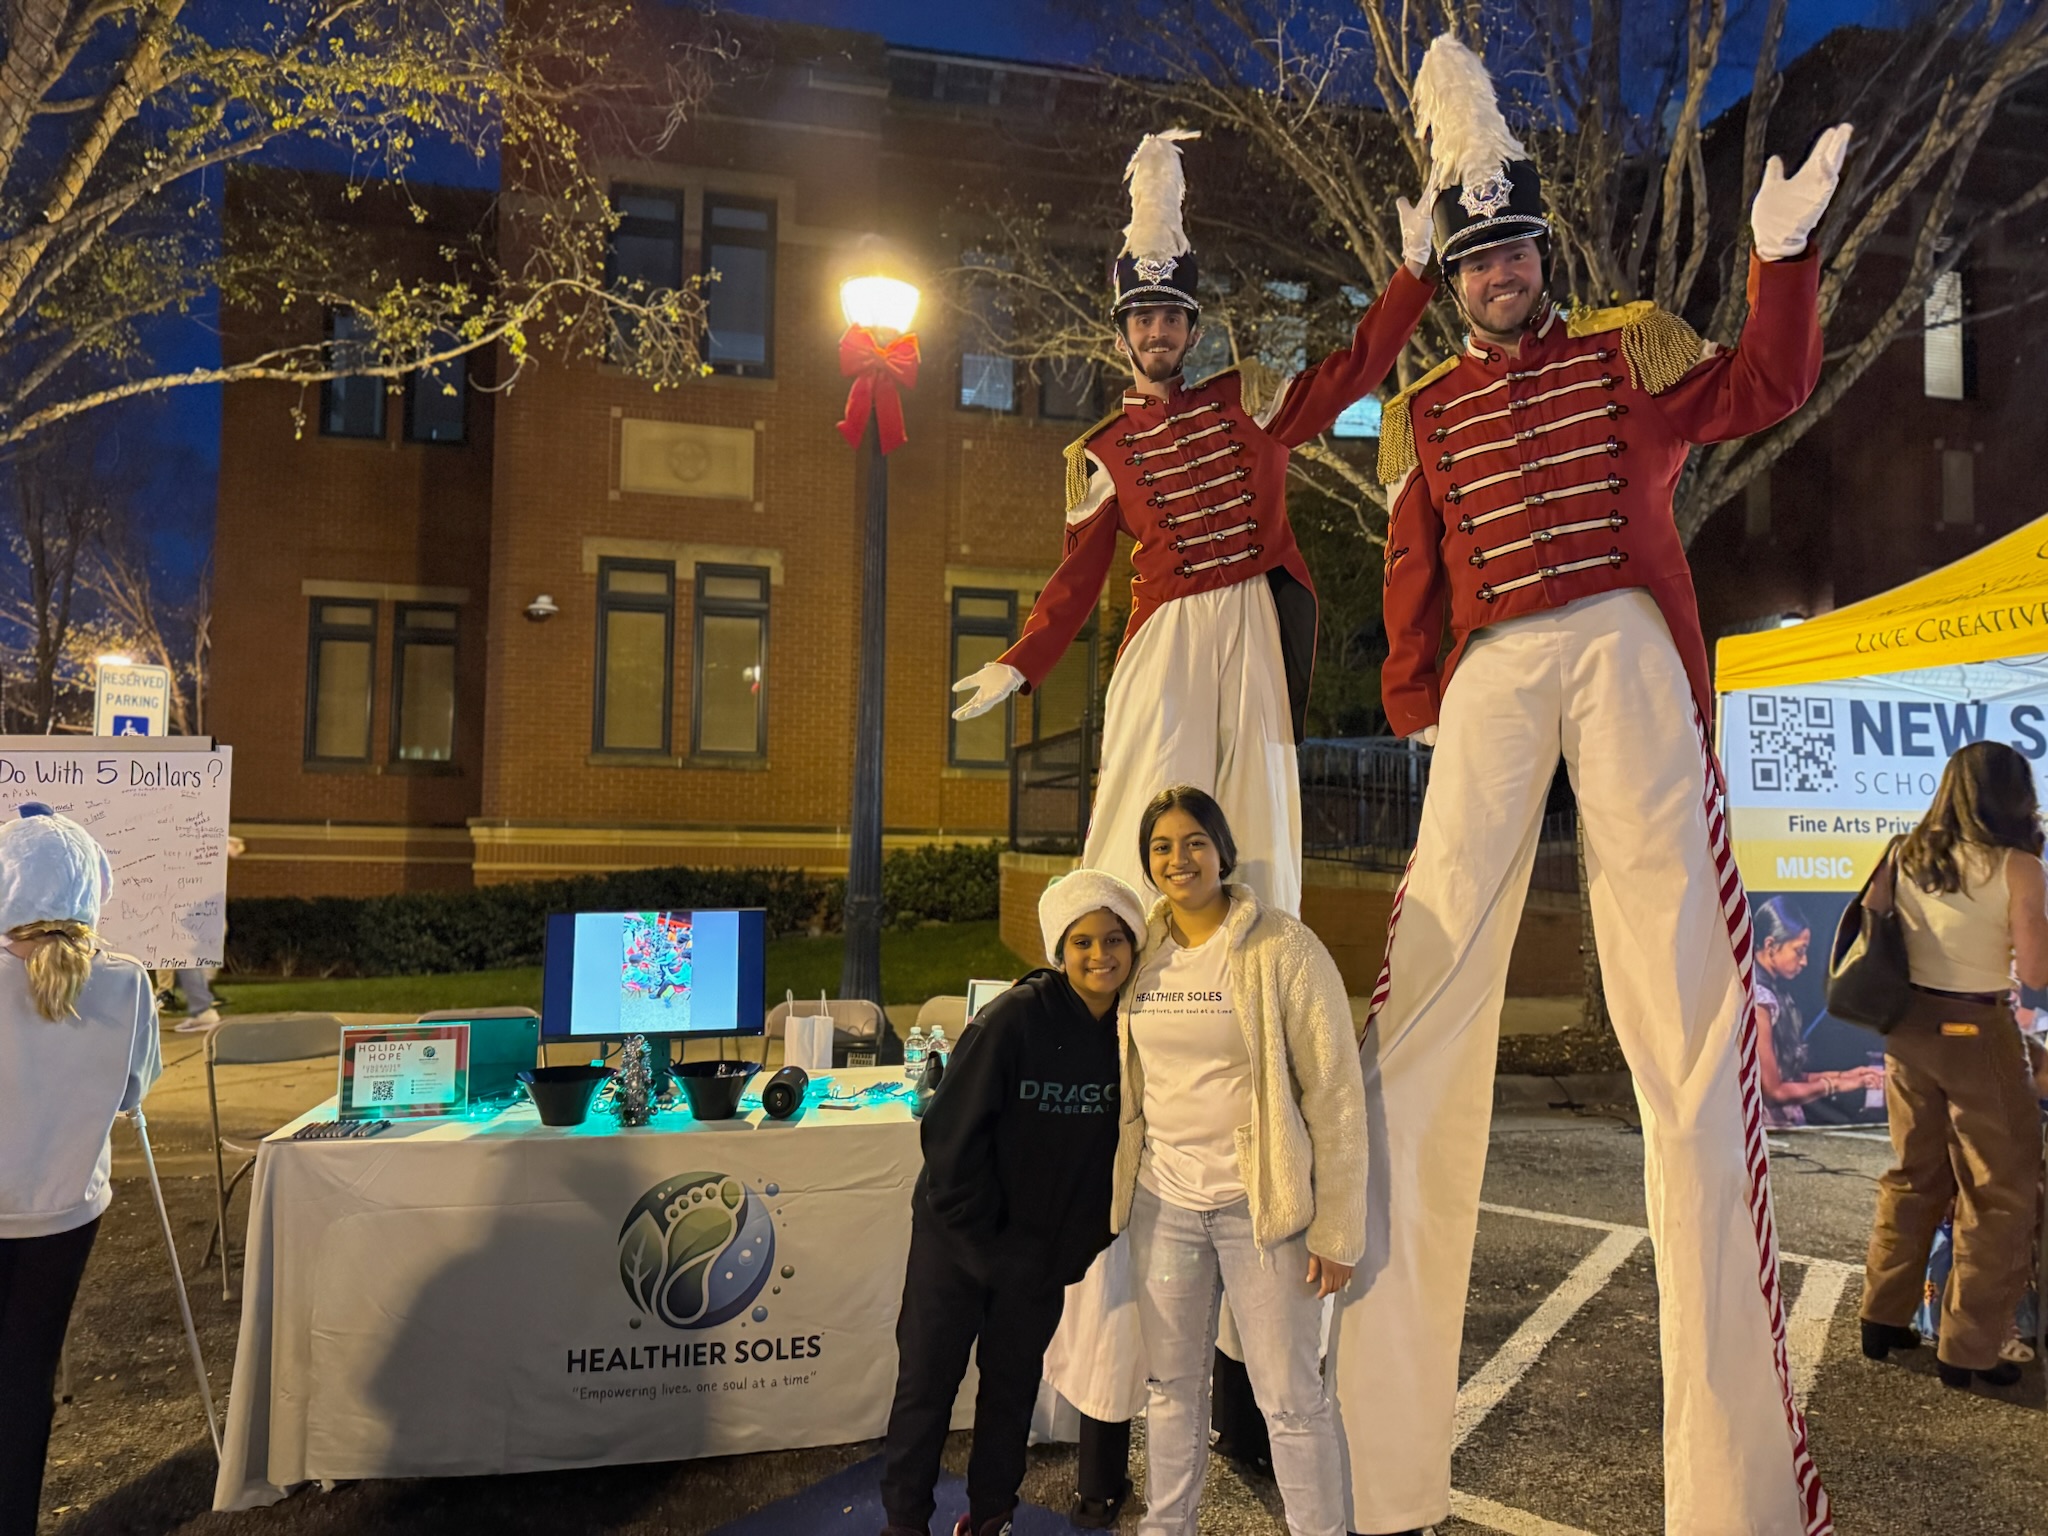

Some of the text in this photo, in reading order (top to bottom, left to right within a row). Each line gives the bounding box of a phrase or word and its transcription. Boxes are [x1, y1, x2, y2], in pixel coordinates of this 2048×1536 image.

[1855, 627, 1909, 654] LIVE
[103, 672, 164, 689] RESERVED
[106, 692, 159, 709] PARKING
[1850, 699, 1988, 757] NEW
[0, 759, 26, 784] Do
[36, 760, 83, 785] With
[96, 760, 118, 785] 5
[130, 760, 201, 788] Dollars
[1854, 771, 1936, 796] SCHO
[1788, 815, 1920, 834] Fine Arts Priva
[1776, 856, 1854, 880] MUSIC
[1136, 991, 1222, 1003] HEALTHIER SOLES
[358, 1042, 413, 1053] HOLIDAY
[369, 1052, 402, 1062] HOPE
[1019, 1079, 1119, 1104] DRAGO
[1038, 1102, 1110, 1115] BASEBA
[567, 1335, 822, 1374] HEALTHIER SOLES
[572, 1383, 657, 1404] "Empowering
[696, 1382, 718, 1393] one
[722, 1377, 748, 1391] soul
[752, 1376, 766, 1389] at
[770, 1379, 778, 1388] a
[783, 1370, 817, 1387] time"
